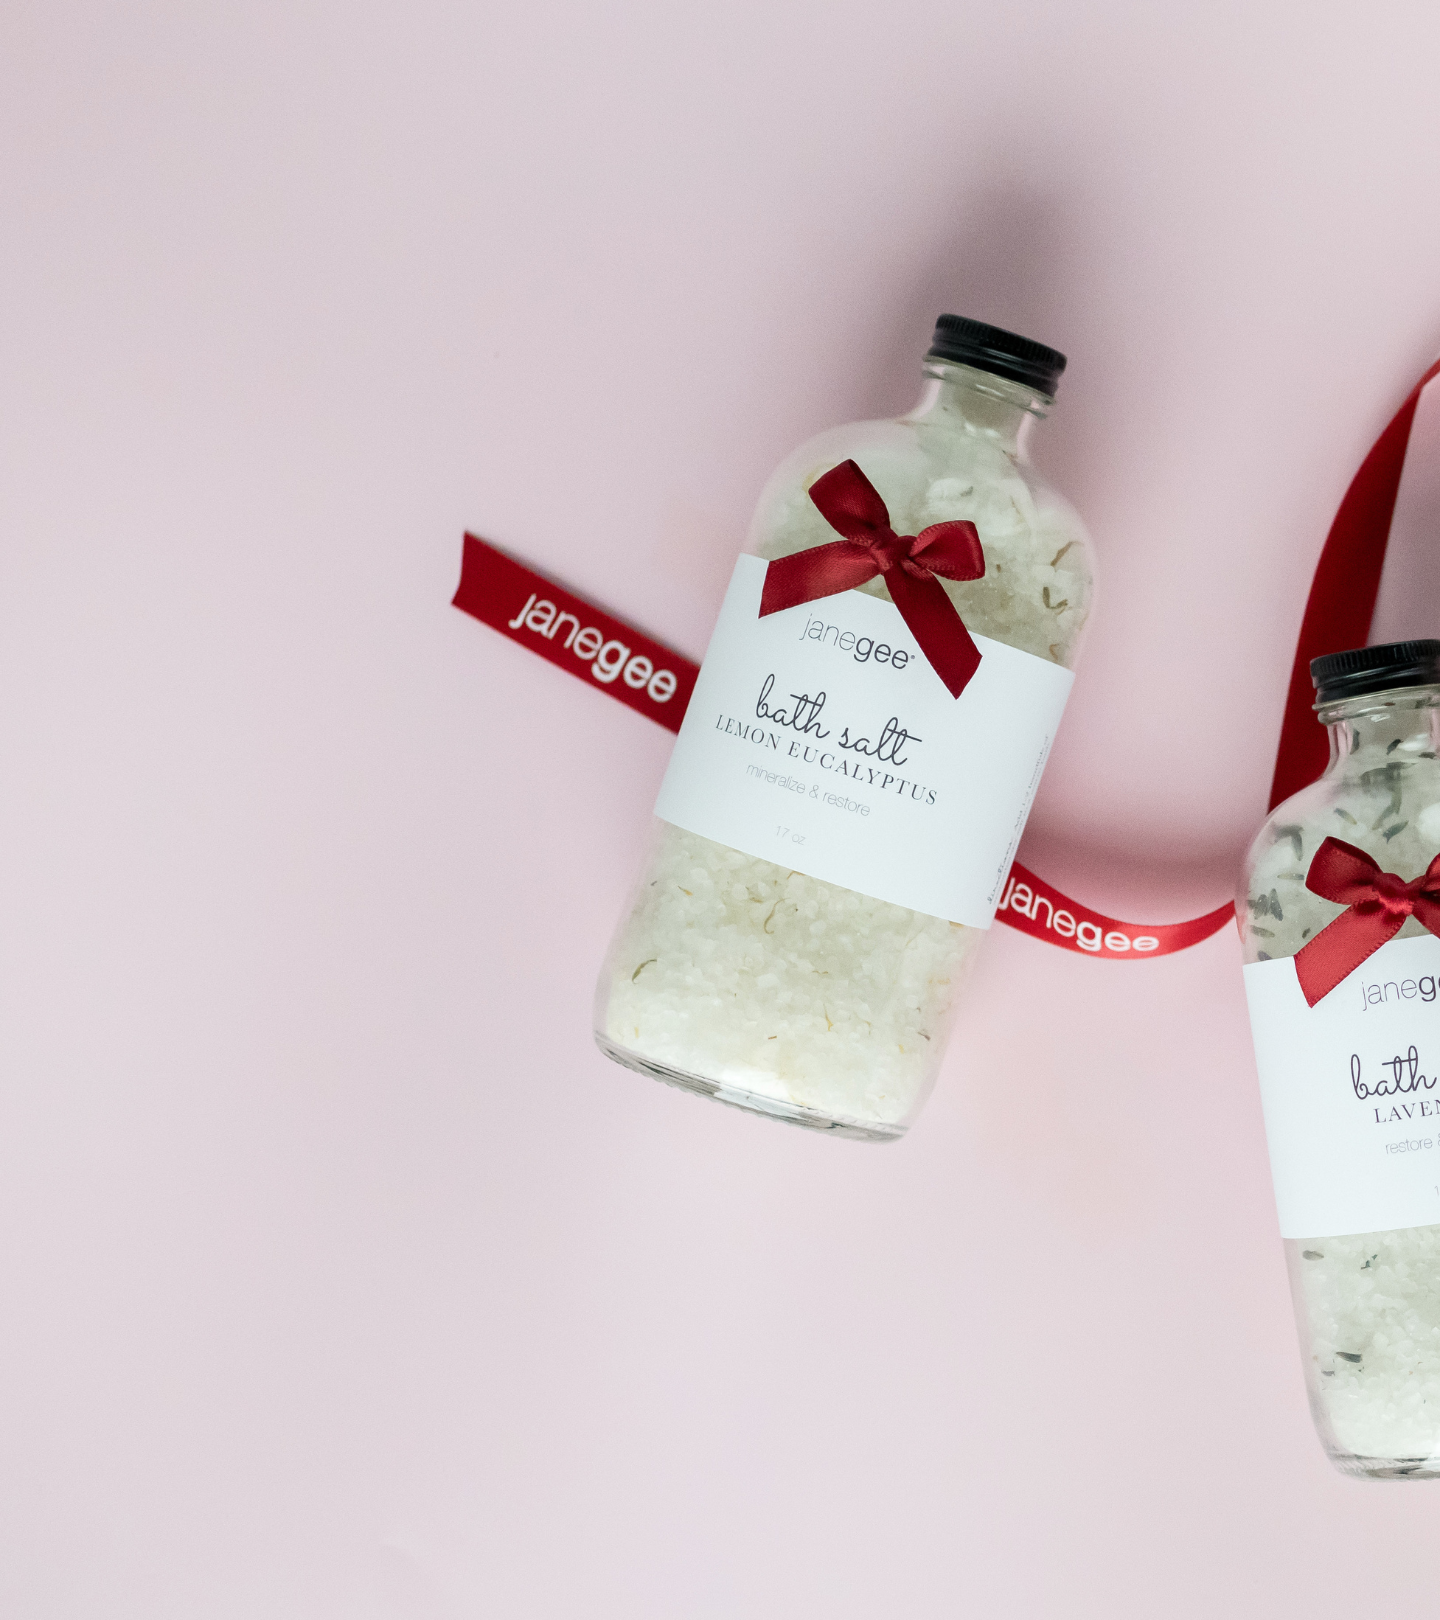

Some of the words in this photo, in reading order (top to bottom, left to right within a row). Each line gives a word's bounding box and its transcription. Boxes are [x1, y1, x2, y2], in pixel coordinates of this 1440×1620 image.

[509, 593, 677, 702] janegee
[755, 674, 831, 739] bath
[837, 716, 923, 767] salt
[715, 713, 781, 750] LEMON
[787, 740, 938, 805] EUCALYPTUS
[745, 763, 806, 795] mineralize
[808, 784, 820, 800] &
[822, 791, 871, 817] restore
[775, 825, 791, 838] 17
[791, 833, 807, 846] oz
[1350, 1044, 1438, 1101] bath
[1384, 1137, 1434, 1155] restore
